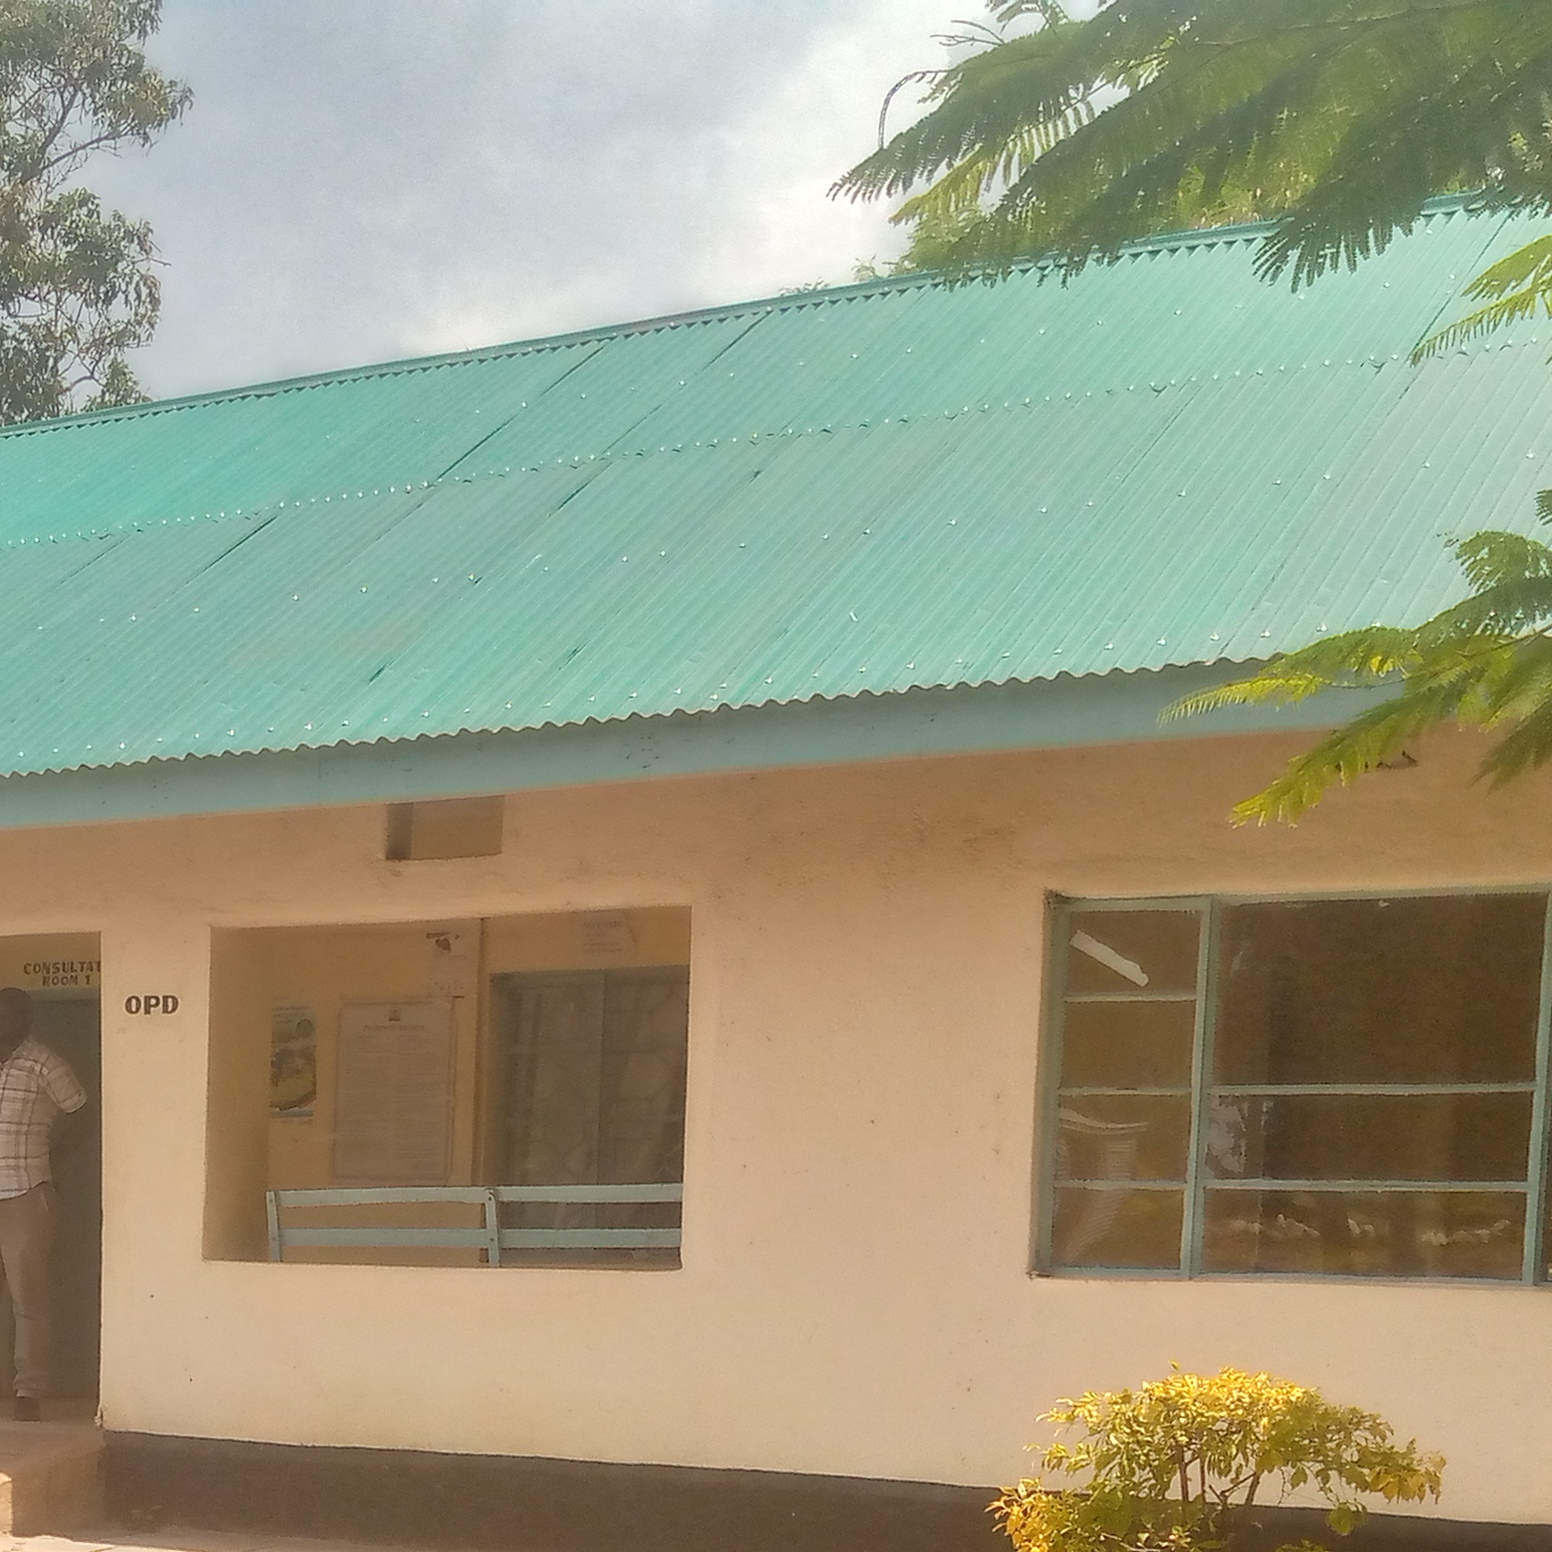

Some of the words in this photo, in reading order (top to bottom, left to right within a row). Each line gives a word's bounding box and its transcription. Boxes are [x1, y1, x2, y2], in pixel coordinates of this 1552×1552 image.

[42, 974, 78, 986] ROOM
[85, 974, 91, 986] 1
[125, 995, 179, 1015] OPD
